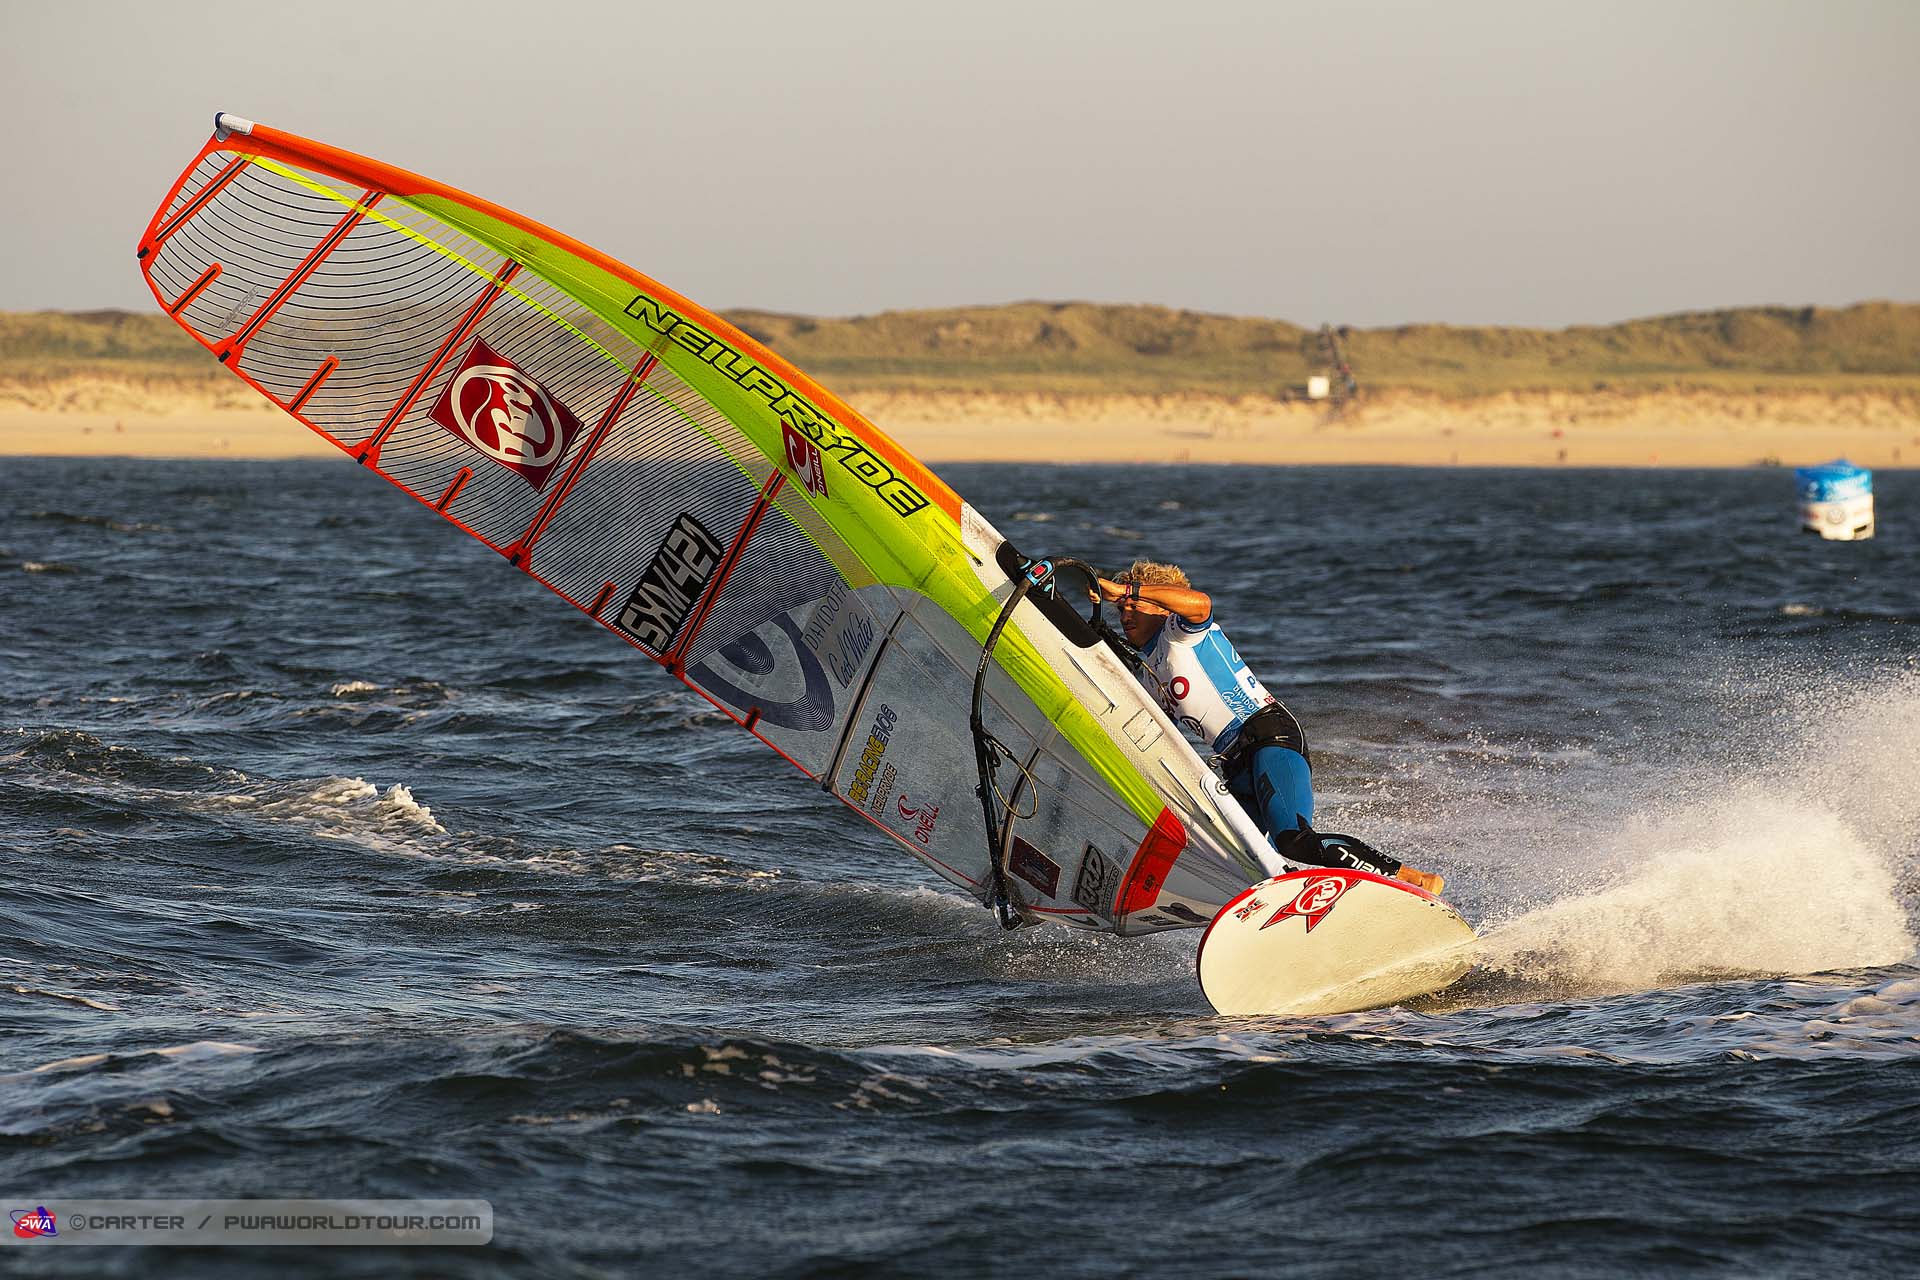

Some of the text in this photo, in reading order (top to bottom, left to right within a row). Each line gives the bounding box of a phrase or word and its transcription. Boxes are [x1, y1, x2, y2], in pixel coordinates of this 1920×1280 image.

[624, 294, 930, 518] NEILPRYDE
[620, 516, 721, 650] SXM421
[804, 577, 848, 651] DAVIDOFF
[914, 802, 940, 844] ONEILL
